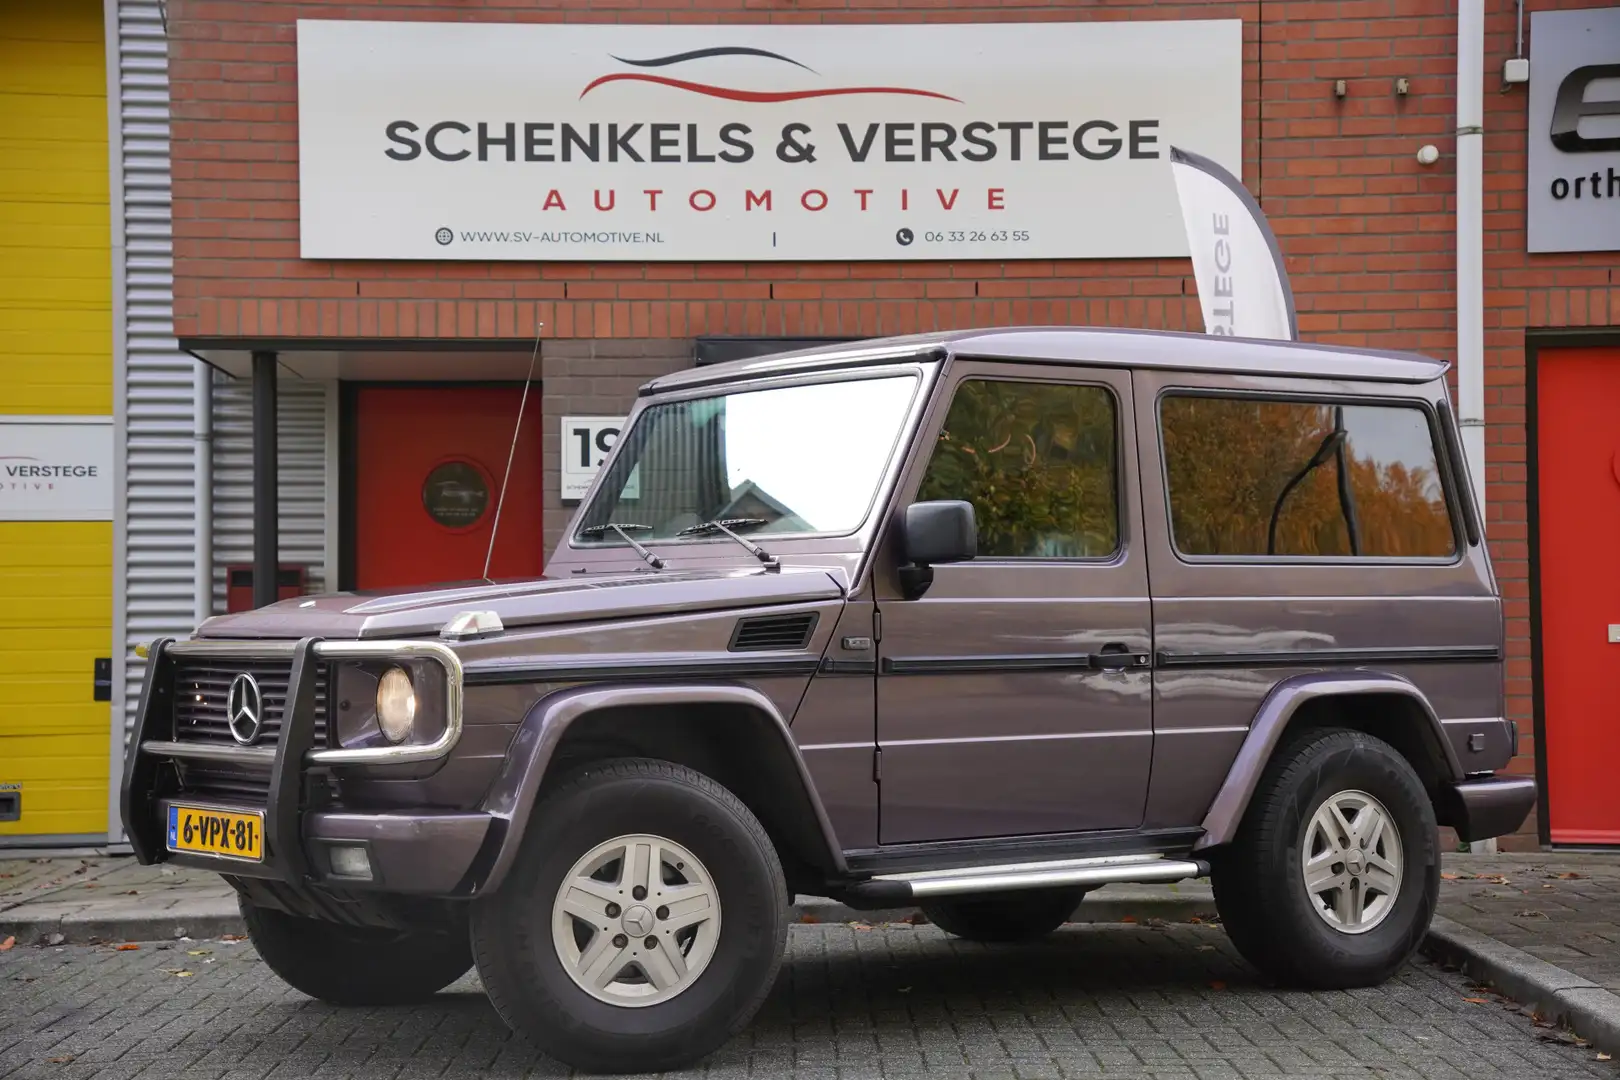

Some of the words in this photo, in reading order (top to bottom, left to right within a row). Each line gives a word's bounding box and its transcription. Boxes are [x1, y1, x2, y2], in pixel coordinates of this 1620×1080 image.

[384, 120, 755, 163] SCHENKELS
[776, 123, 817, 163] &
[837, 120, 1160, 163] VERSTEGE
[542, 188, 1005, 211] AUTOMOTIVE
[460, 231, 665, 243] WWW.SV-AUTOMOTIVE.NL
[924, 231, 944, 242] 06
[948, 231, 965, 242] 33
[969, 231, 987, 242] 26
[990, 230, 1008, 241] 63
[1012, 230, 1030, 241] 55
[573, 427, 621, 467] 19
[6, 465, 98, 477] VERSTEGE
[183, 814, 253, 851] 6-VPX-81
